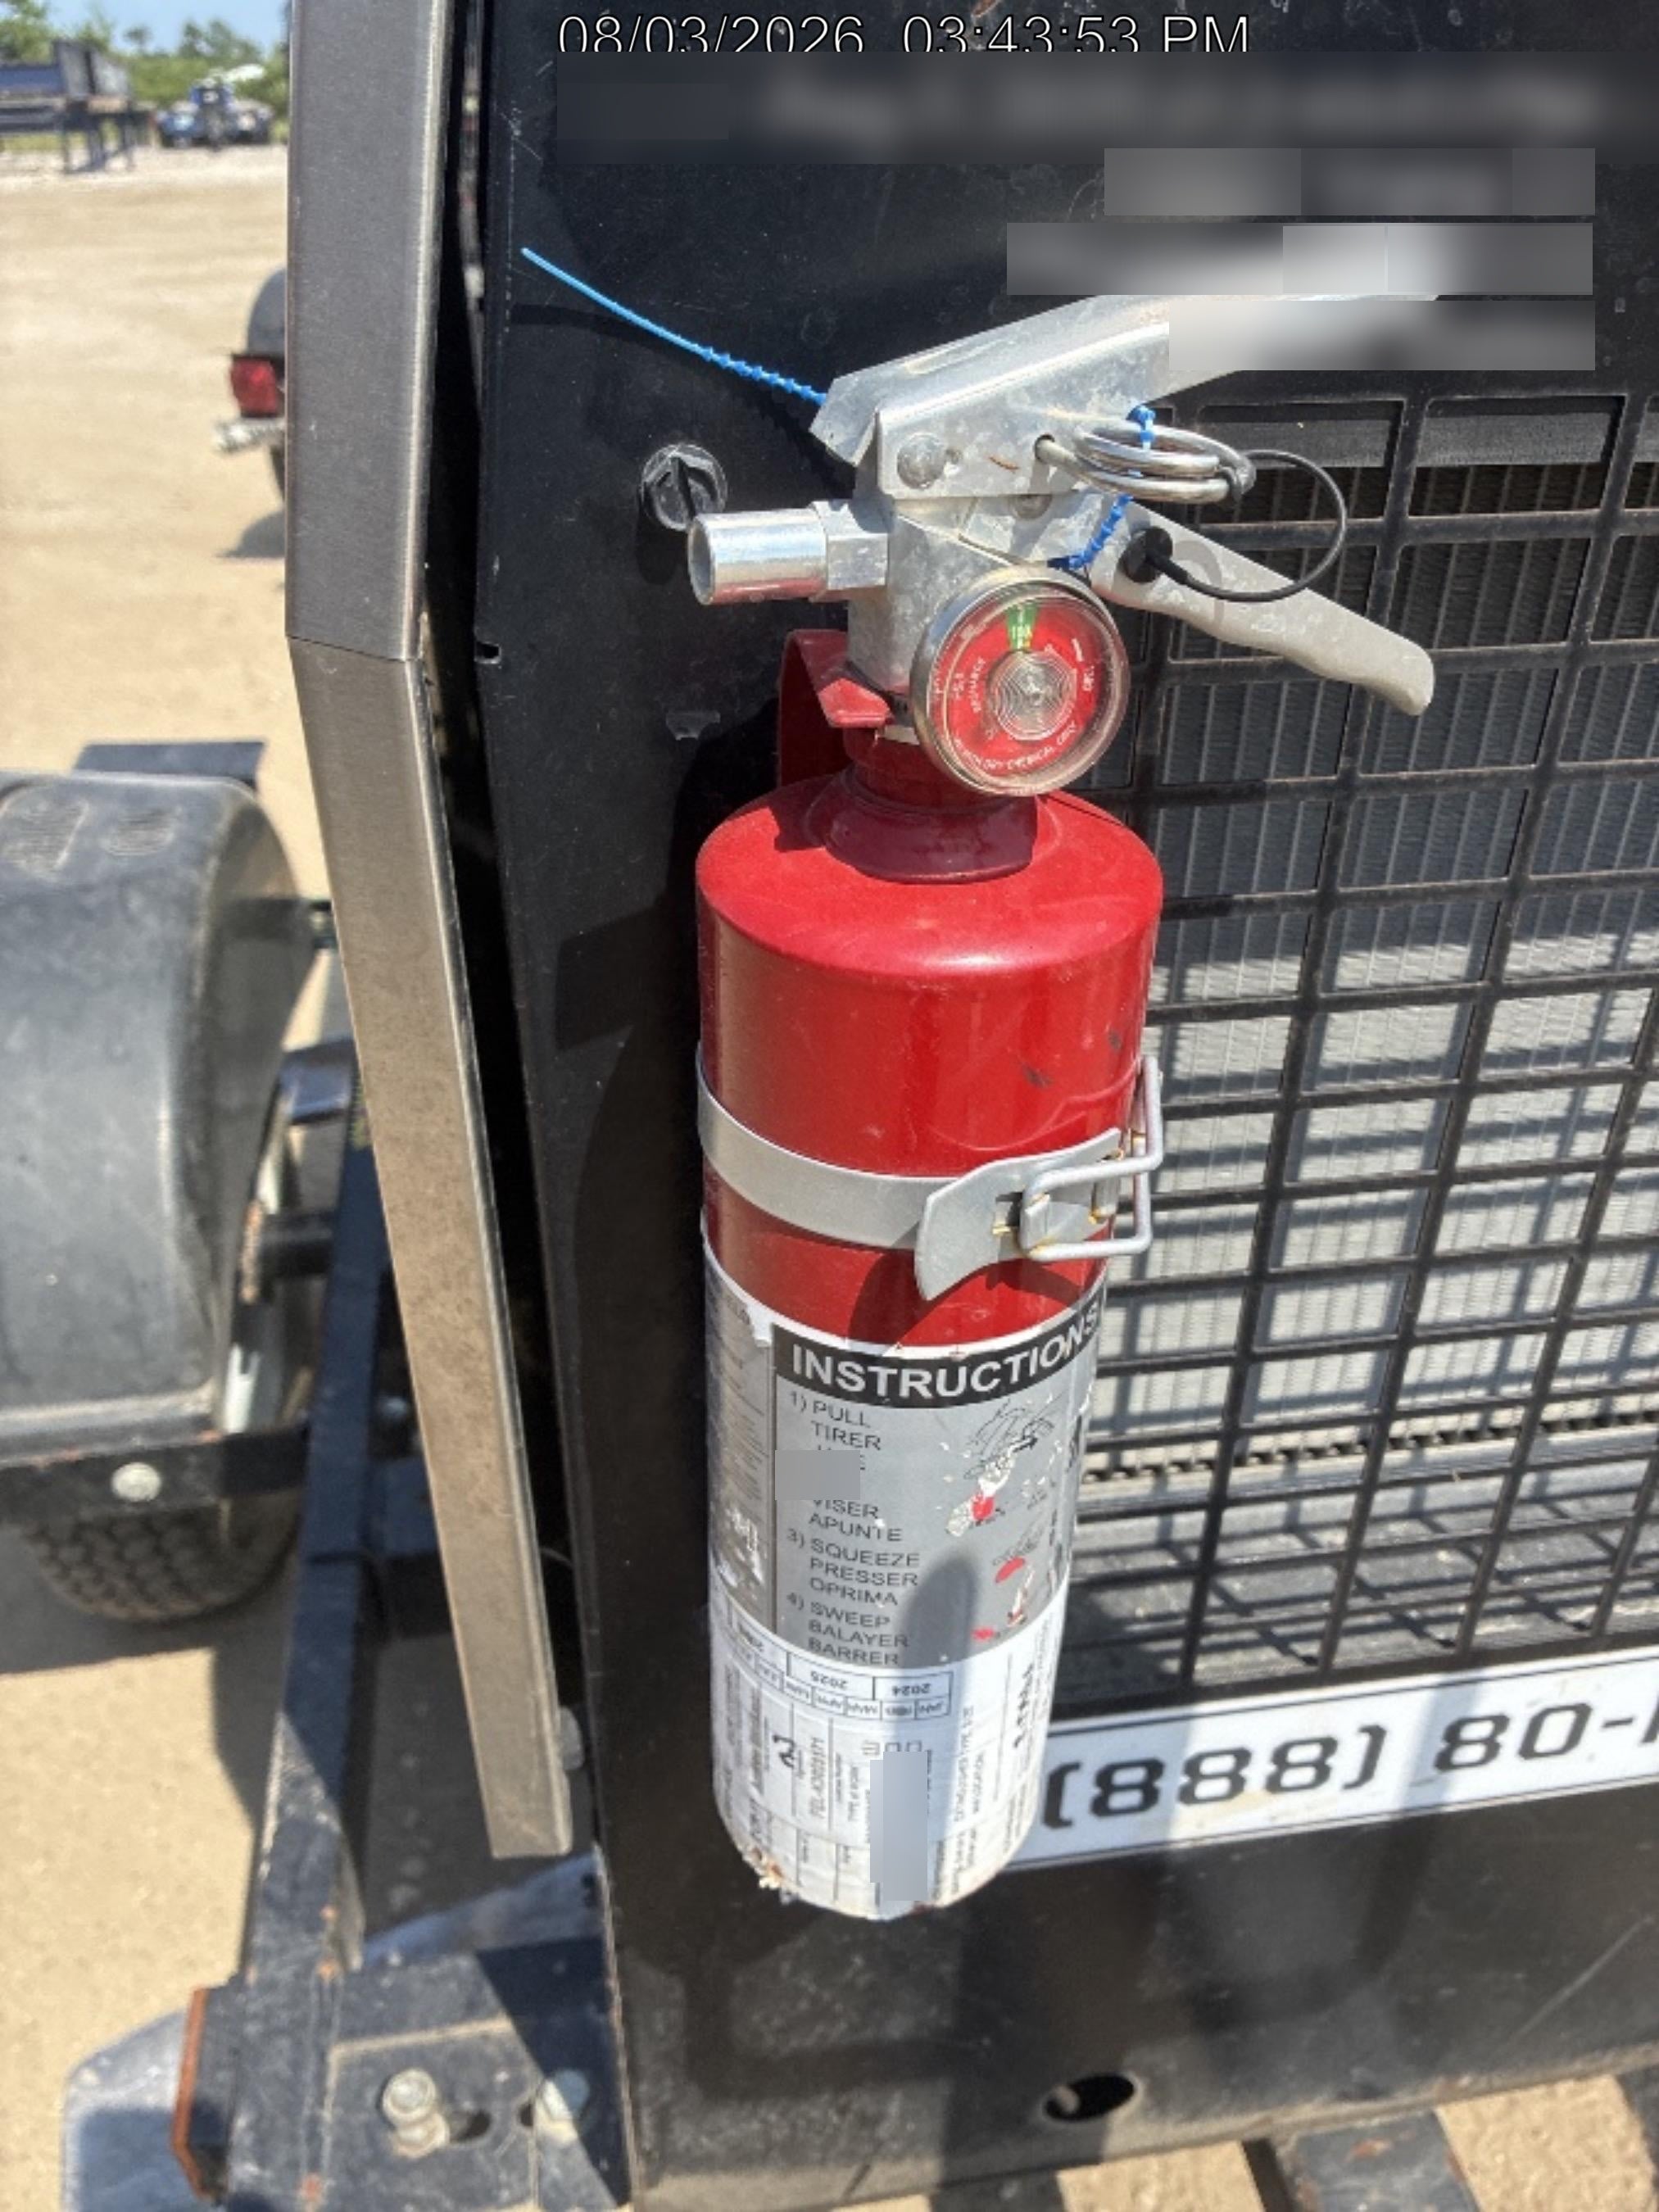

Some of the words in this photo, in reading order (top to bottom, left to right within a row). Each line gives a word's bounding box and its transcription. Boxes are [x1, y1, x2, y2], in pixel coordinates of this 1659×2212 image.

[791, 1300, 1098, 1398] INSTRUCTIONS
[813, 1399, 872, 1429] PULL
[810, 1419, 882, 1451] TIRER
[808, 1513, 904, 1543] APUNTE
[786, 1527, 805, 1549] 3)
[810, 1536, 920, 1567] SQUEEZE
[809, 1556, 919, 1586] PRESSER
[809, 1576, 898, 1606] OPRIMA
[810, 1601, 891, 1628] SWEEP
[808, 1619, 909, 1648] BALAYER
[808, 1637, 899, 1666] BARRER
[891, 1682, 932, 1697] 2024
[1042, 1723, 1387, 1829] (888)
[1433, 1689, 1659, 1774] 80-
